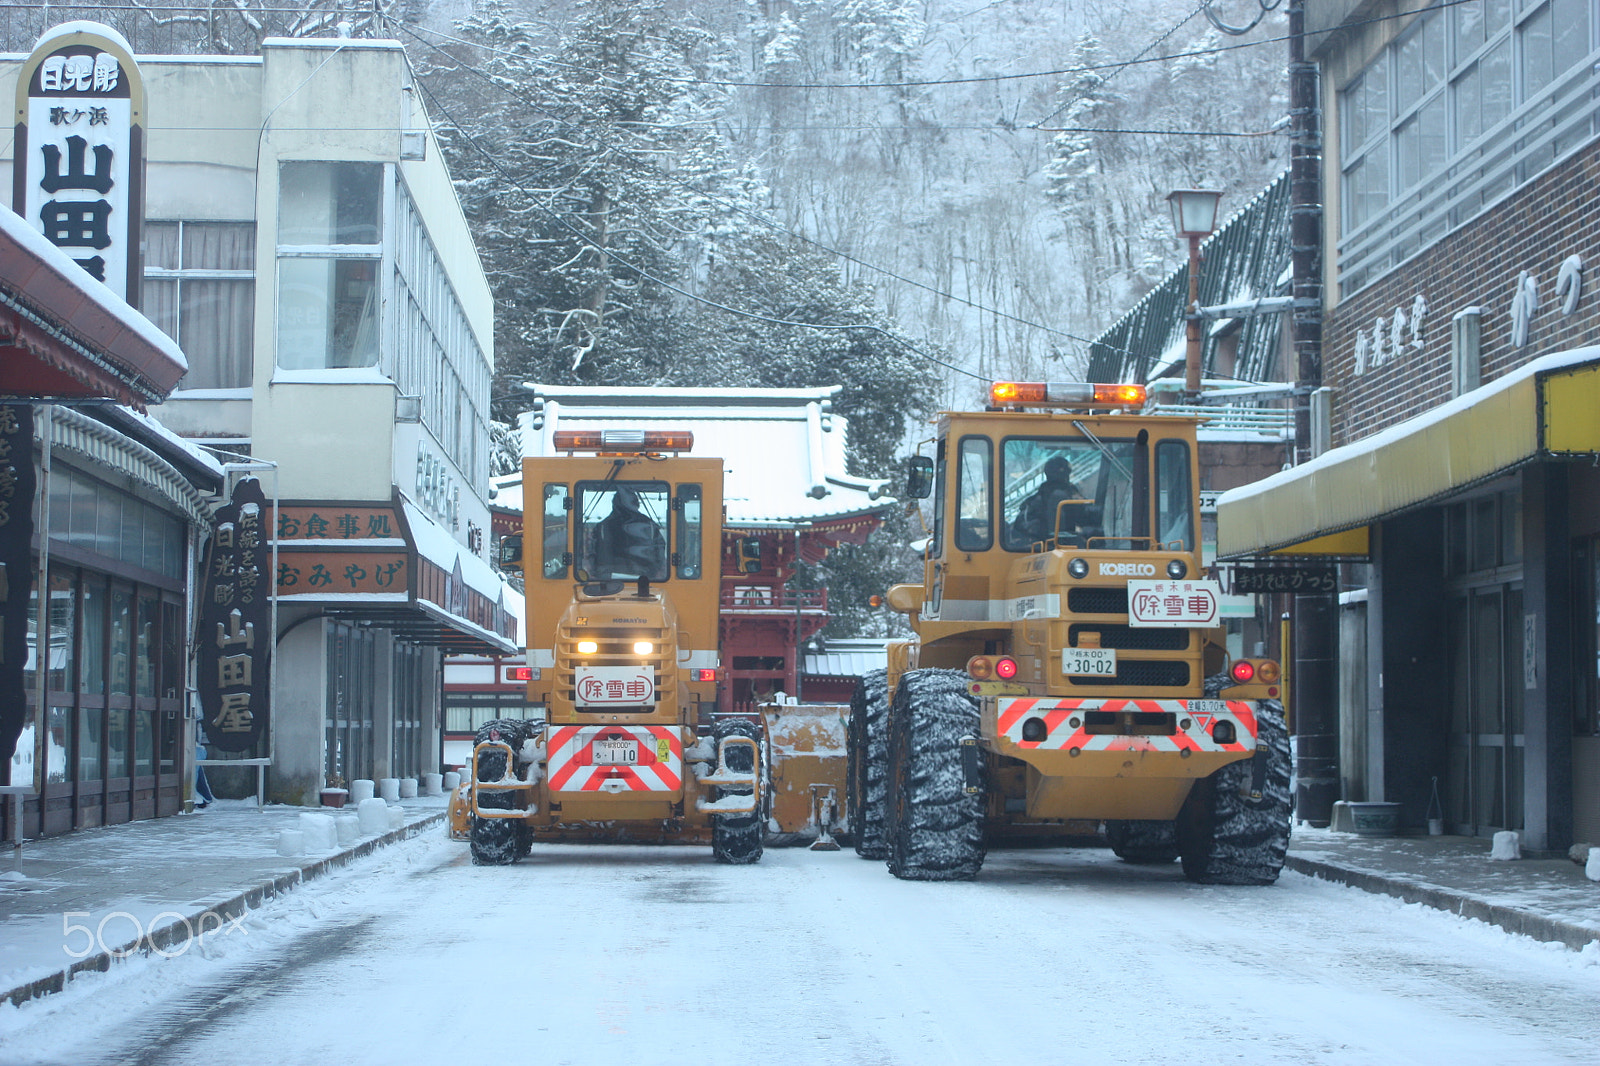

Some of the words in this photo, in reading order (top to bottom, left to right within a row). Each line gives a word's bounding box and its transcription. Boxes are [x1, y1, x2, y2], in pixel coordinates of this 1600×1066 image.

[277, 513, 392, 538] お食事処
[213, 522, 236, 607] 日光彫
[238, 503, 261, 605] 伝統を誇る
[277, 560, 404, 588] おみやげ
[1099, 563, 1156, 576] KOBELCO
[1155, 584, 1192, 592] 栃木県
[1139, 595, 1209, 616] 除雪車
[212, 608, 256, 734] 山田屋
[585, 680, 646, 699] 除雪車
